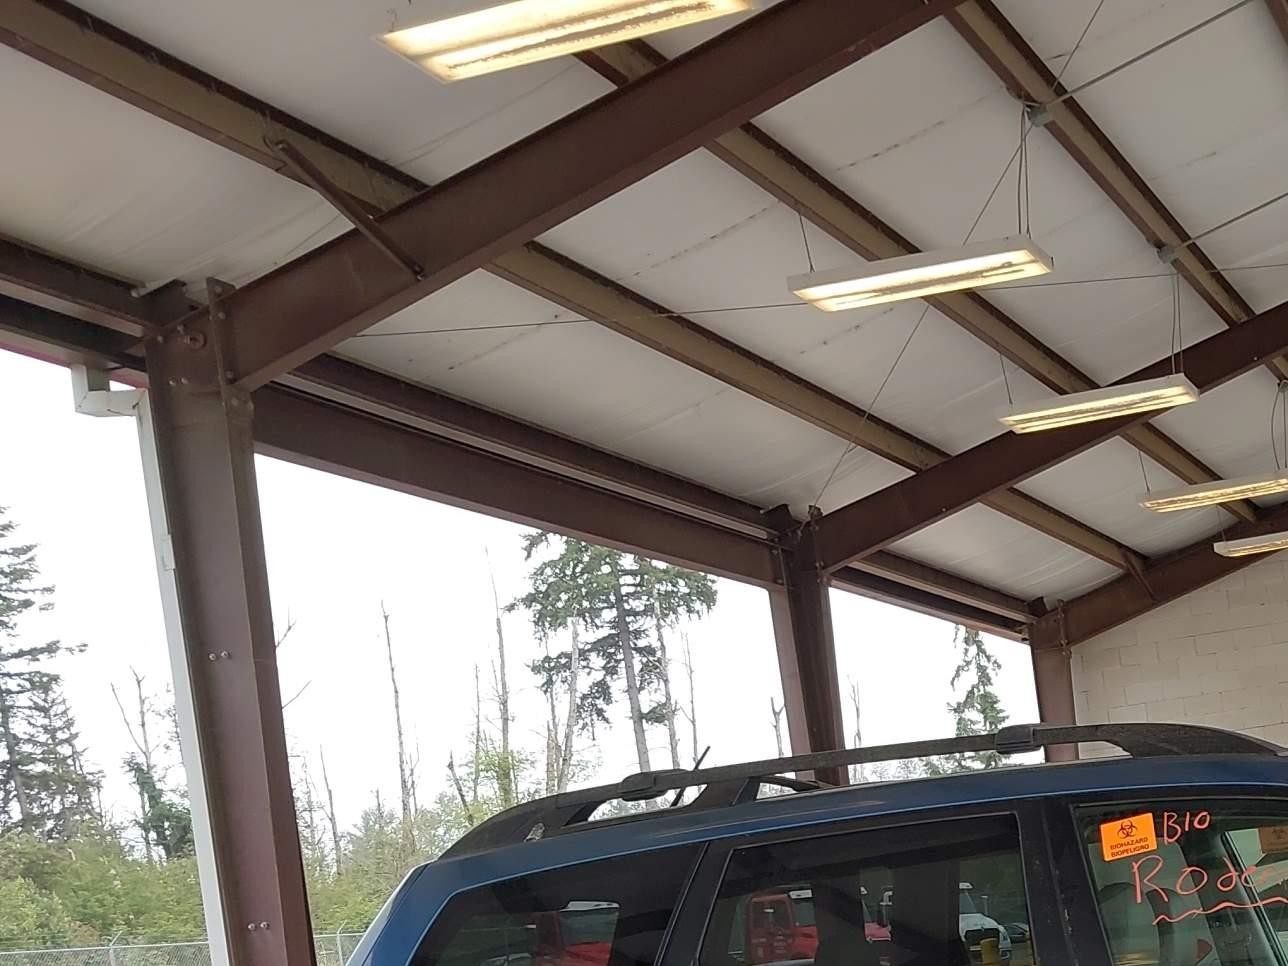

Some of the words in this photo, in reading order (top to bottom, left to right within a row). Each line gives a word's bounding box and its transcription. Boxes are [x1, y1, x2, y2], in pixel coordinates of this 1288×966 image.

[1163, 811, 1211, 845] BIO
[1110, 837, 1149, 851] BIOHAZARD
[1111, 844, 1150, 858] BIOPELIGRO
